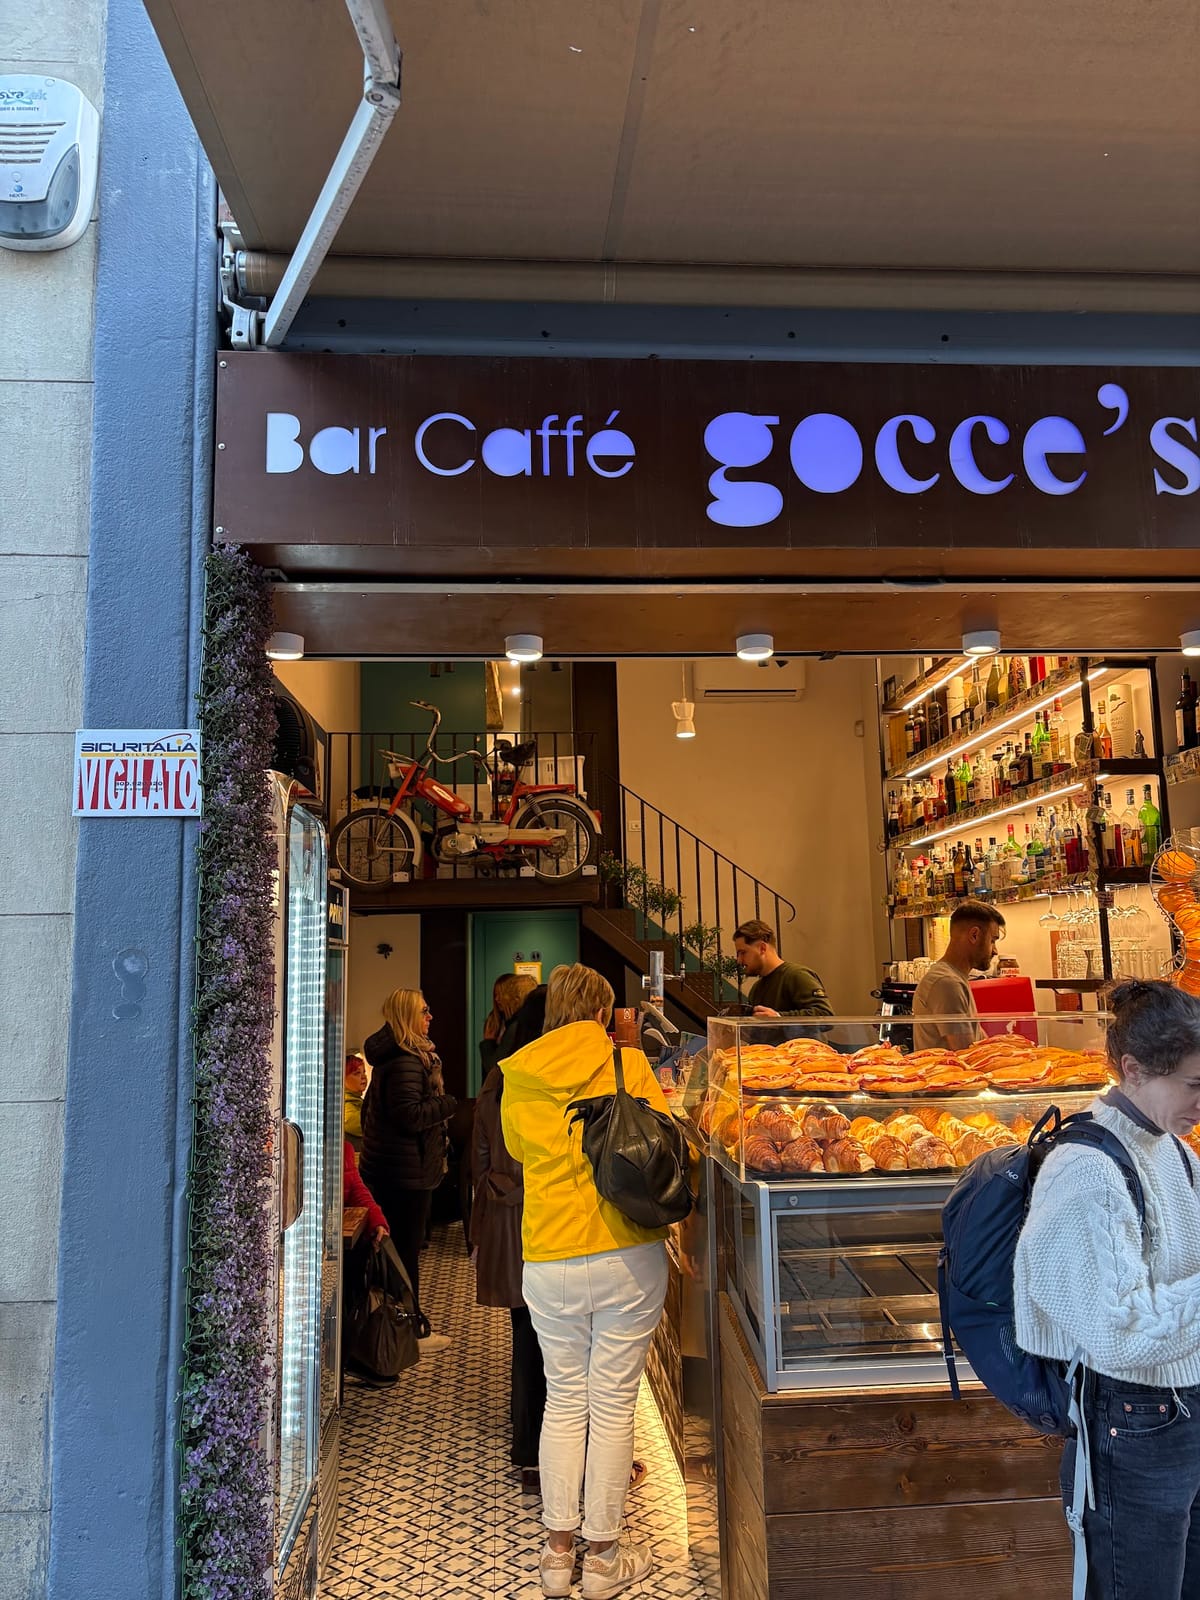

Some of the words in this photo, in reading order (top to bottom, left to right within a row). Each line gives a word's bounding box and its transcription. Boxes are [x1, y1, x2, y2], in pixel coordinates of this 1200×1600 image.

[265, 412, 387, 475] Bar
[414, 409, 636, 478] Caffé
[78, 758, 198, 810] VIGILATO
